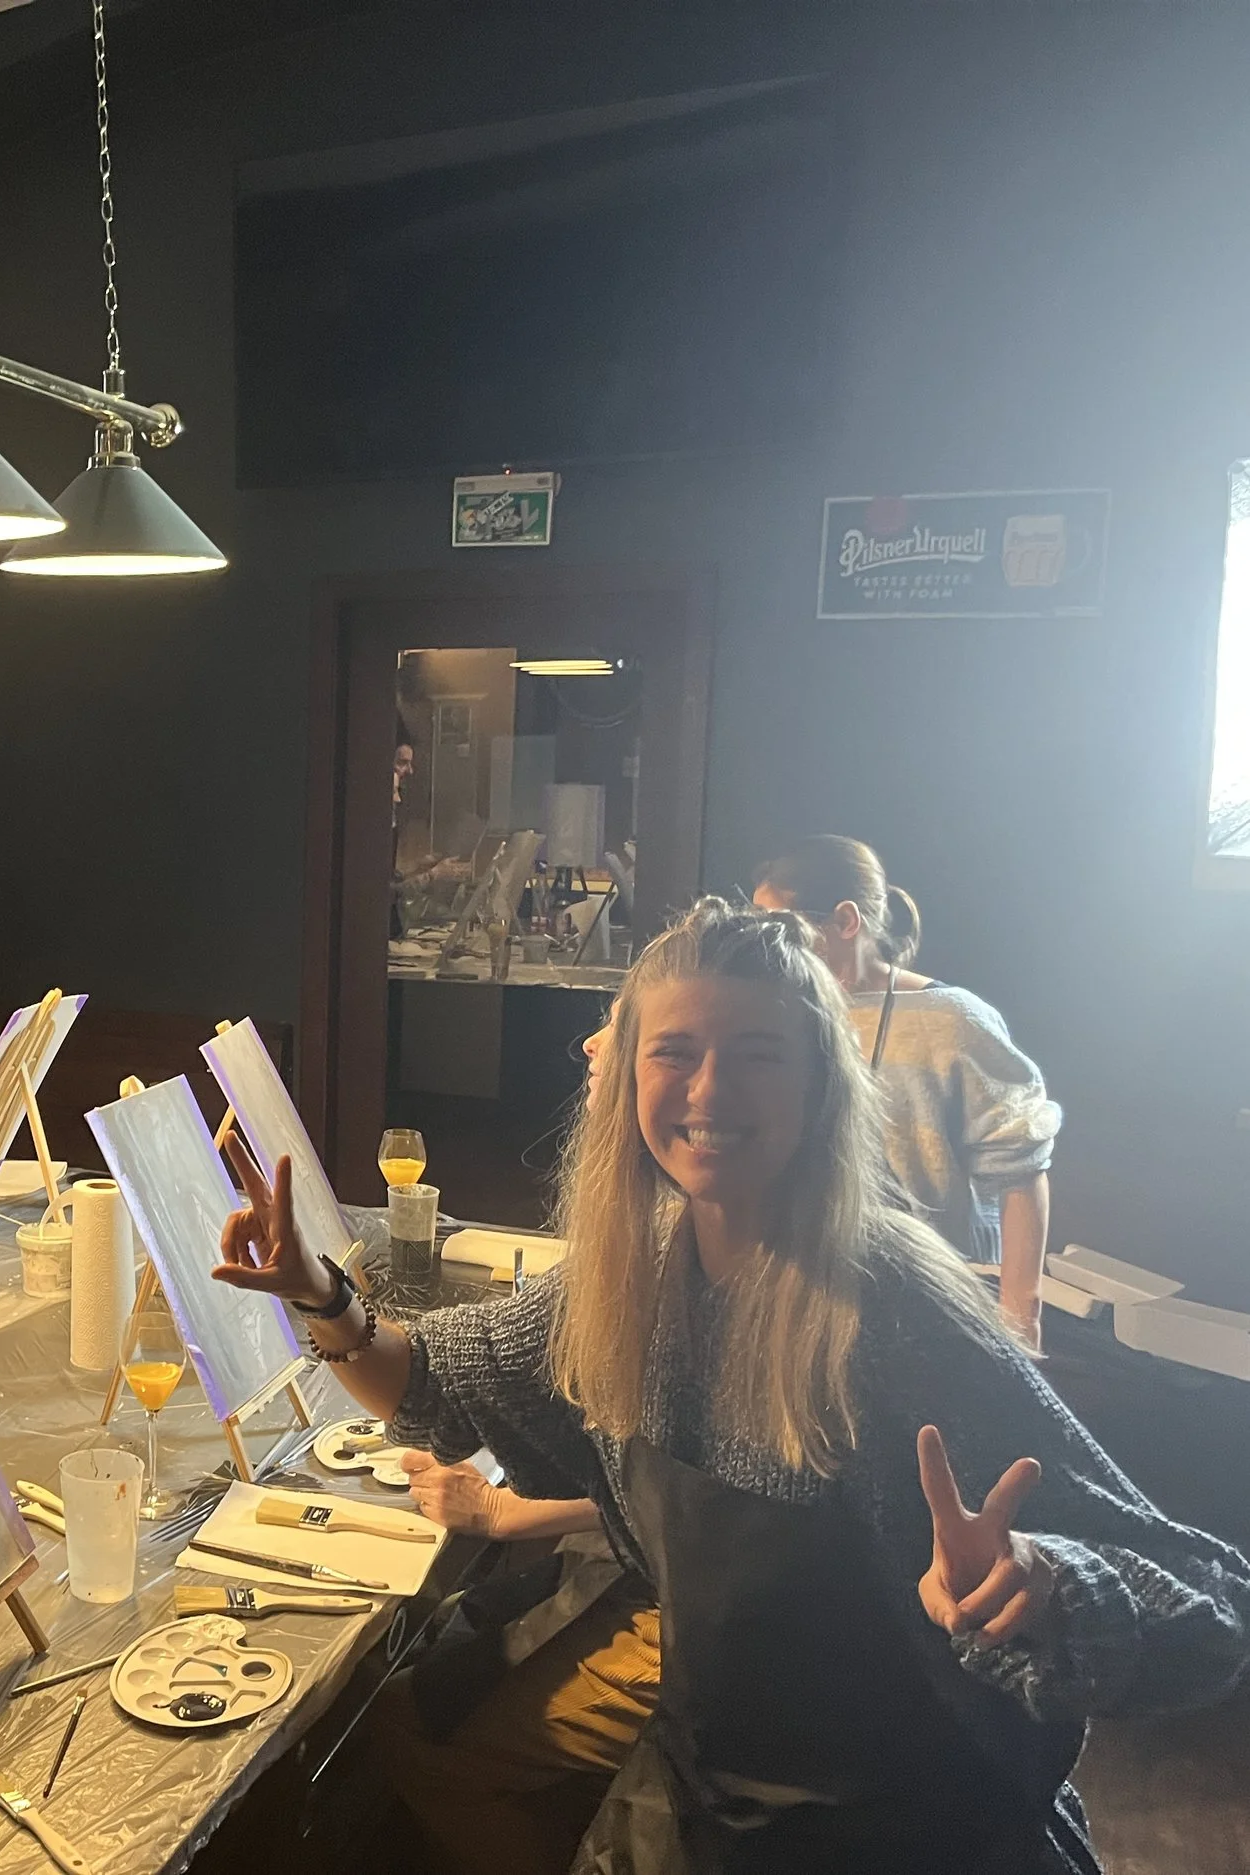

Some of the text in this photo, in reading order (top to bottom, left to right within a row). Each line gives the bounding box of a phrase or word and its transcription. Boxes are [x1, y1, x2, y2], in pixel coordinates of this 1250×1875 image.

[839, 525, 986, 577] Pilsner Urquell
[909, 588, 953, 600] FOAM
